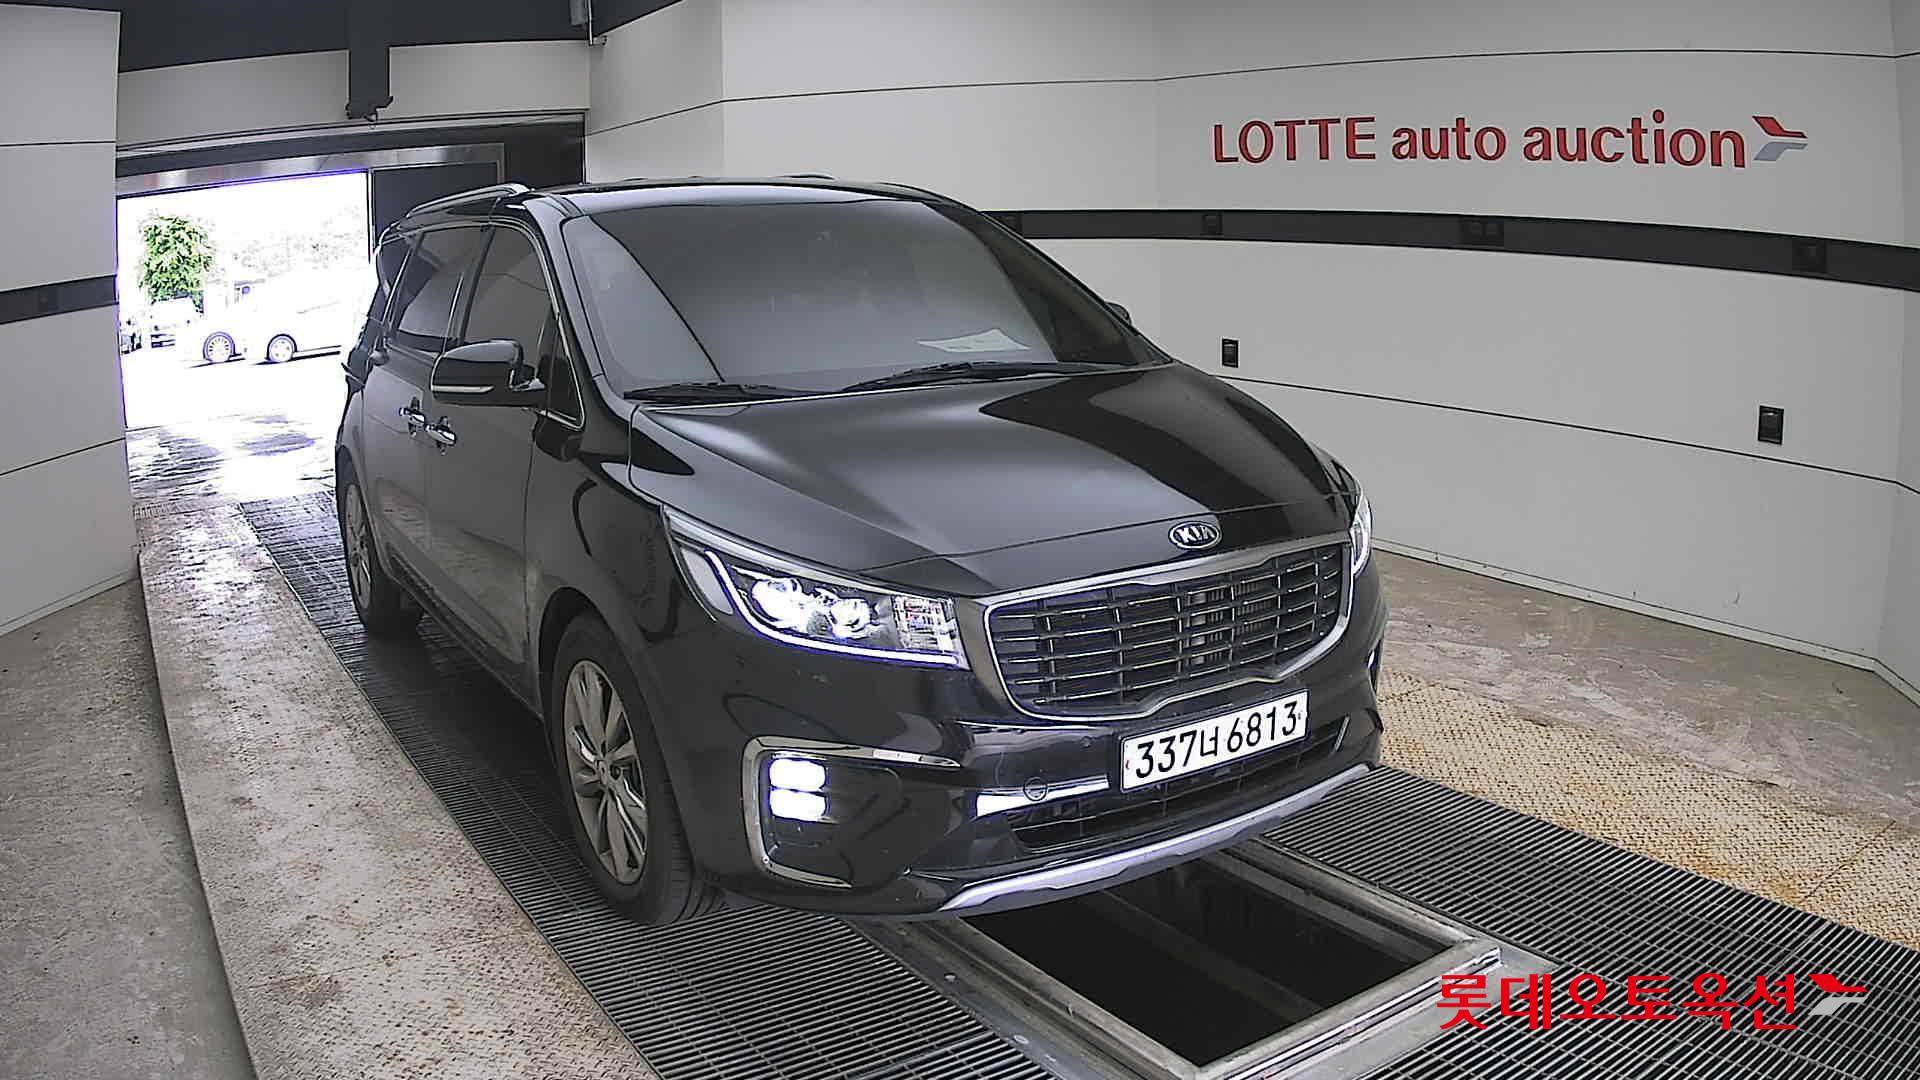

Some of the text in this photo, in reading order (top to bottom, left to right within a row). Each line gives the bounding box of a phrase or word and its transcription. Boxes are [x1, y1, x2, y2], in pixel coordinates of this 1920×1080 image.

[1213, 109, 1747, 168] LOTTE auto auction
[1175, 525, 1216, 544] KIA
[1135, 701, 1298, 778] 337너 6813
